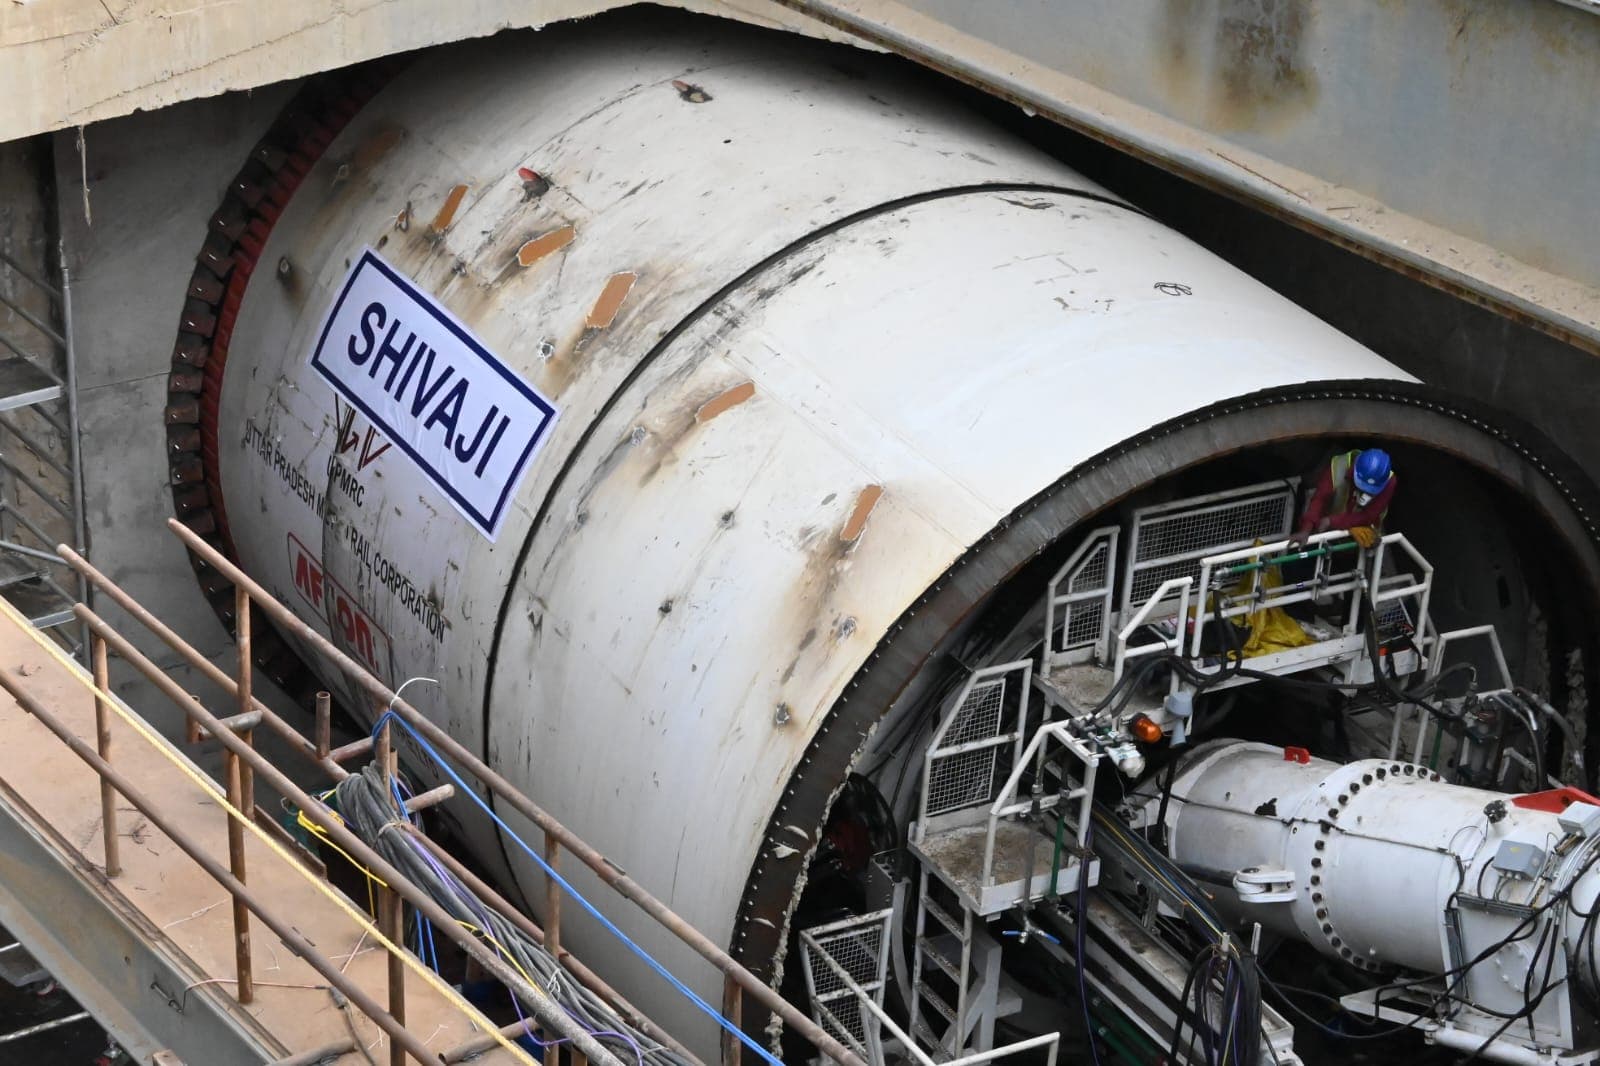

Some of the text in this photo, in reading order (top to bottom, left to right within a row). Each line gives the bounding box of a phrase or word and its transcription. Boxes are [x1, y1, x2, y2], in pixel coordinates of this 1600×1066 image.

[348, 302, 511, 479] SHIVAJI
[273, 450, 317, 513] PRADESH
[351, 528, 372, 569] RAIL
[373, 552, 445, 644] CORPORATION
